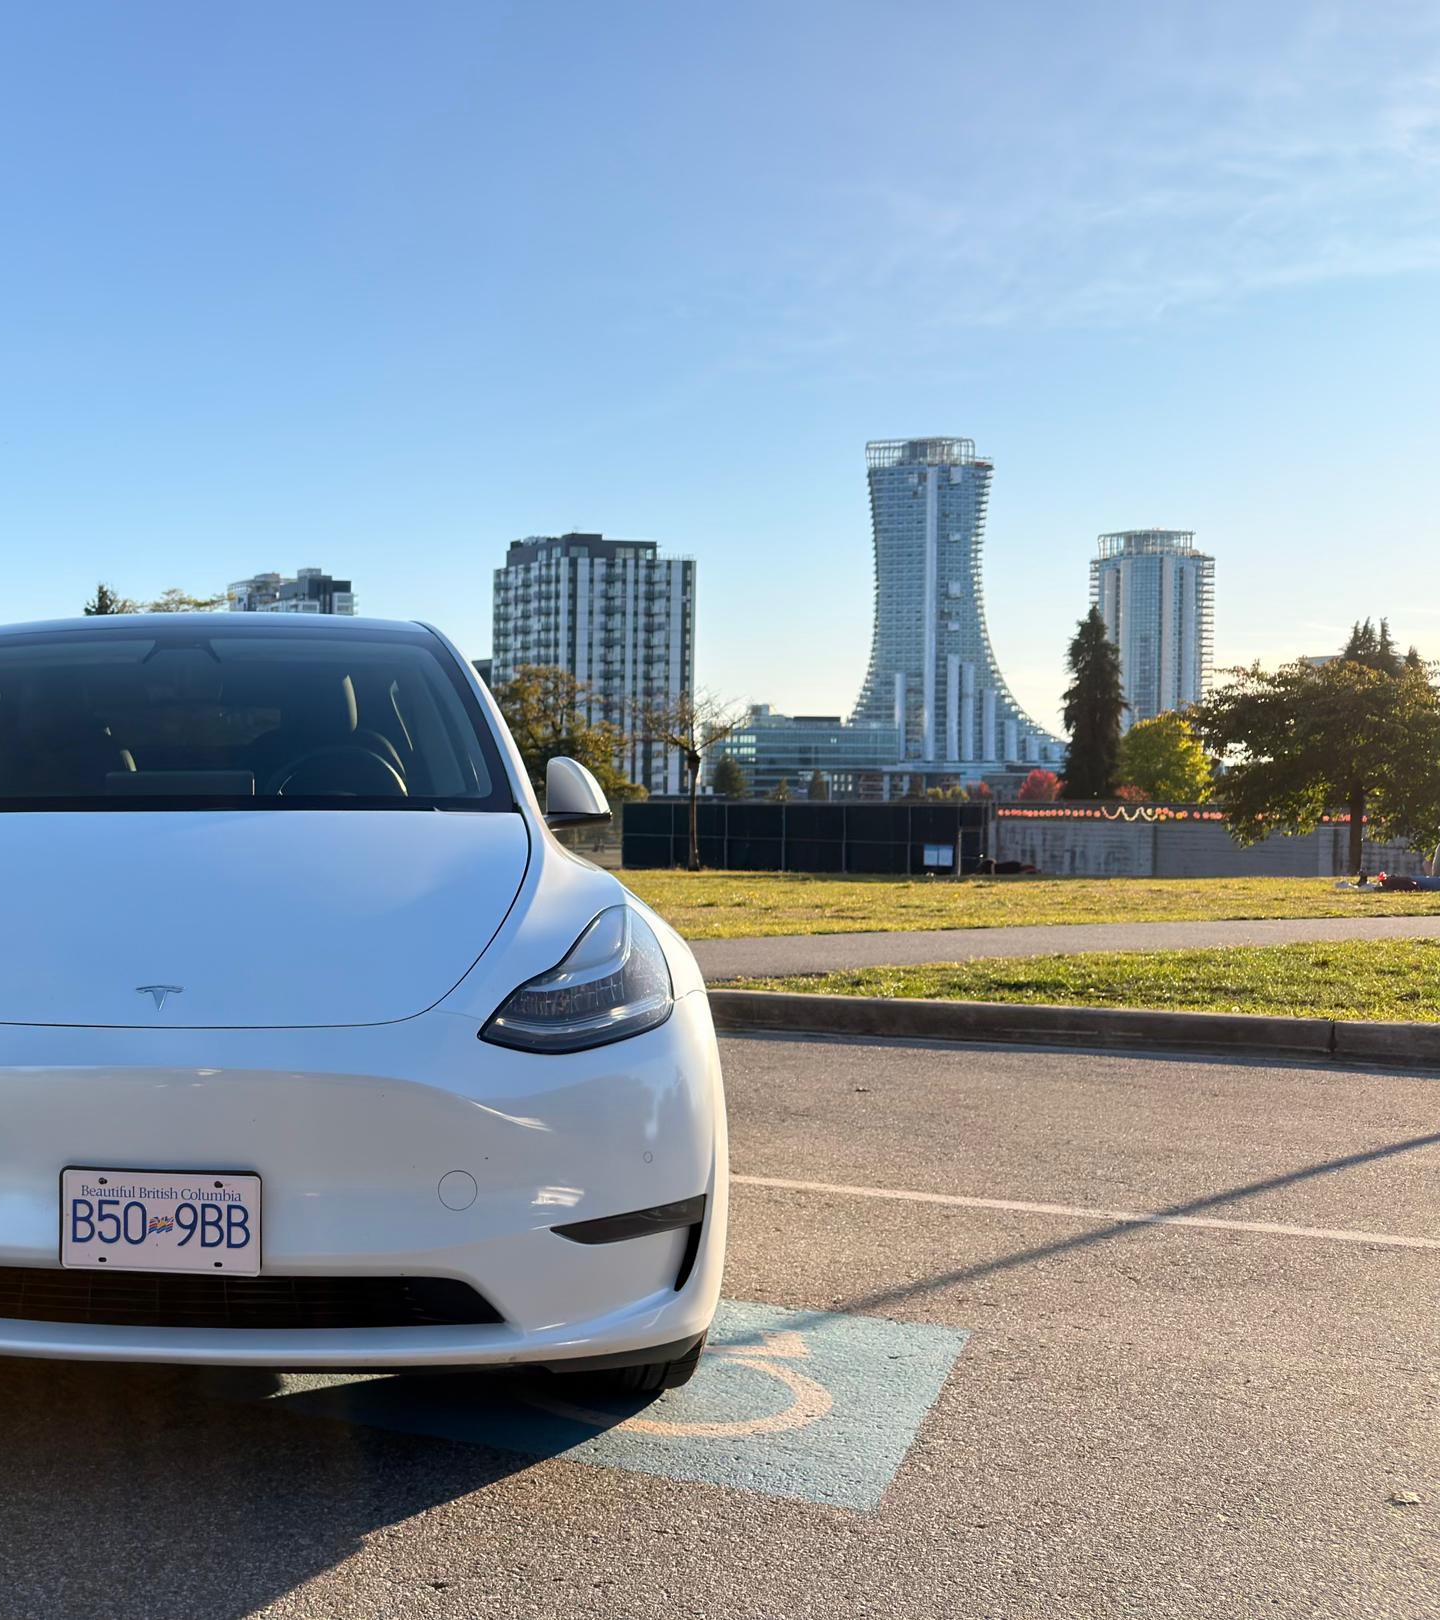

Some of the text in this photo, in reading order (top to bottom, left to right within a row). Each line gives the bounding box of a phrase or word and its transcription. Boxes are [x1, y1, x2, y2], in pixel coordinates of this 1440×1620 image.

[81, 1184, 241, 1202] Beautiful British Columbia
[72, 1199, 250, 1249] B50 9BB
